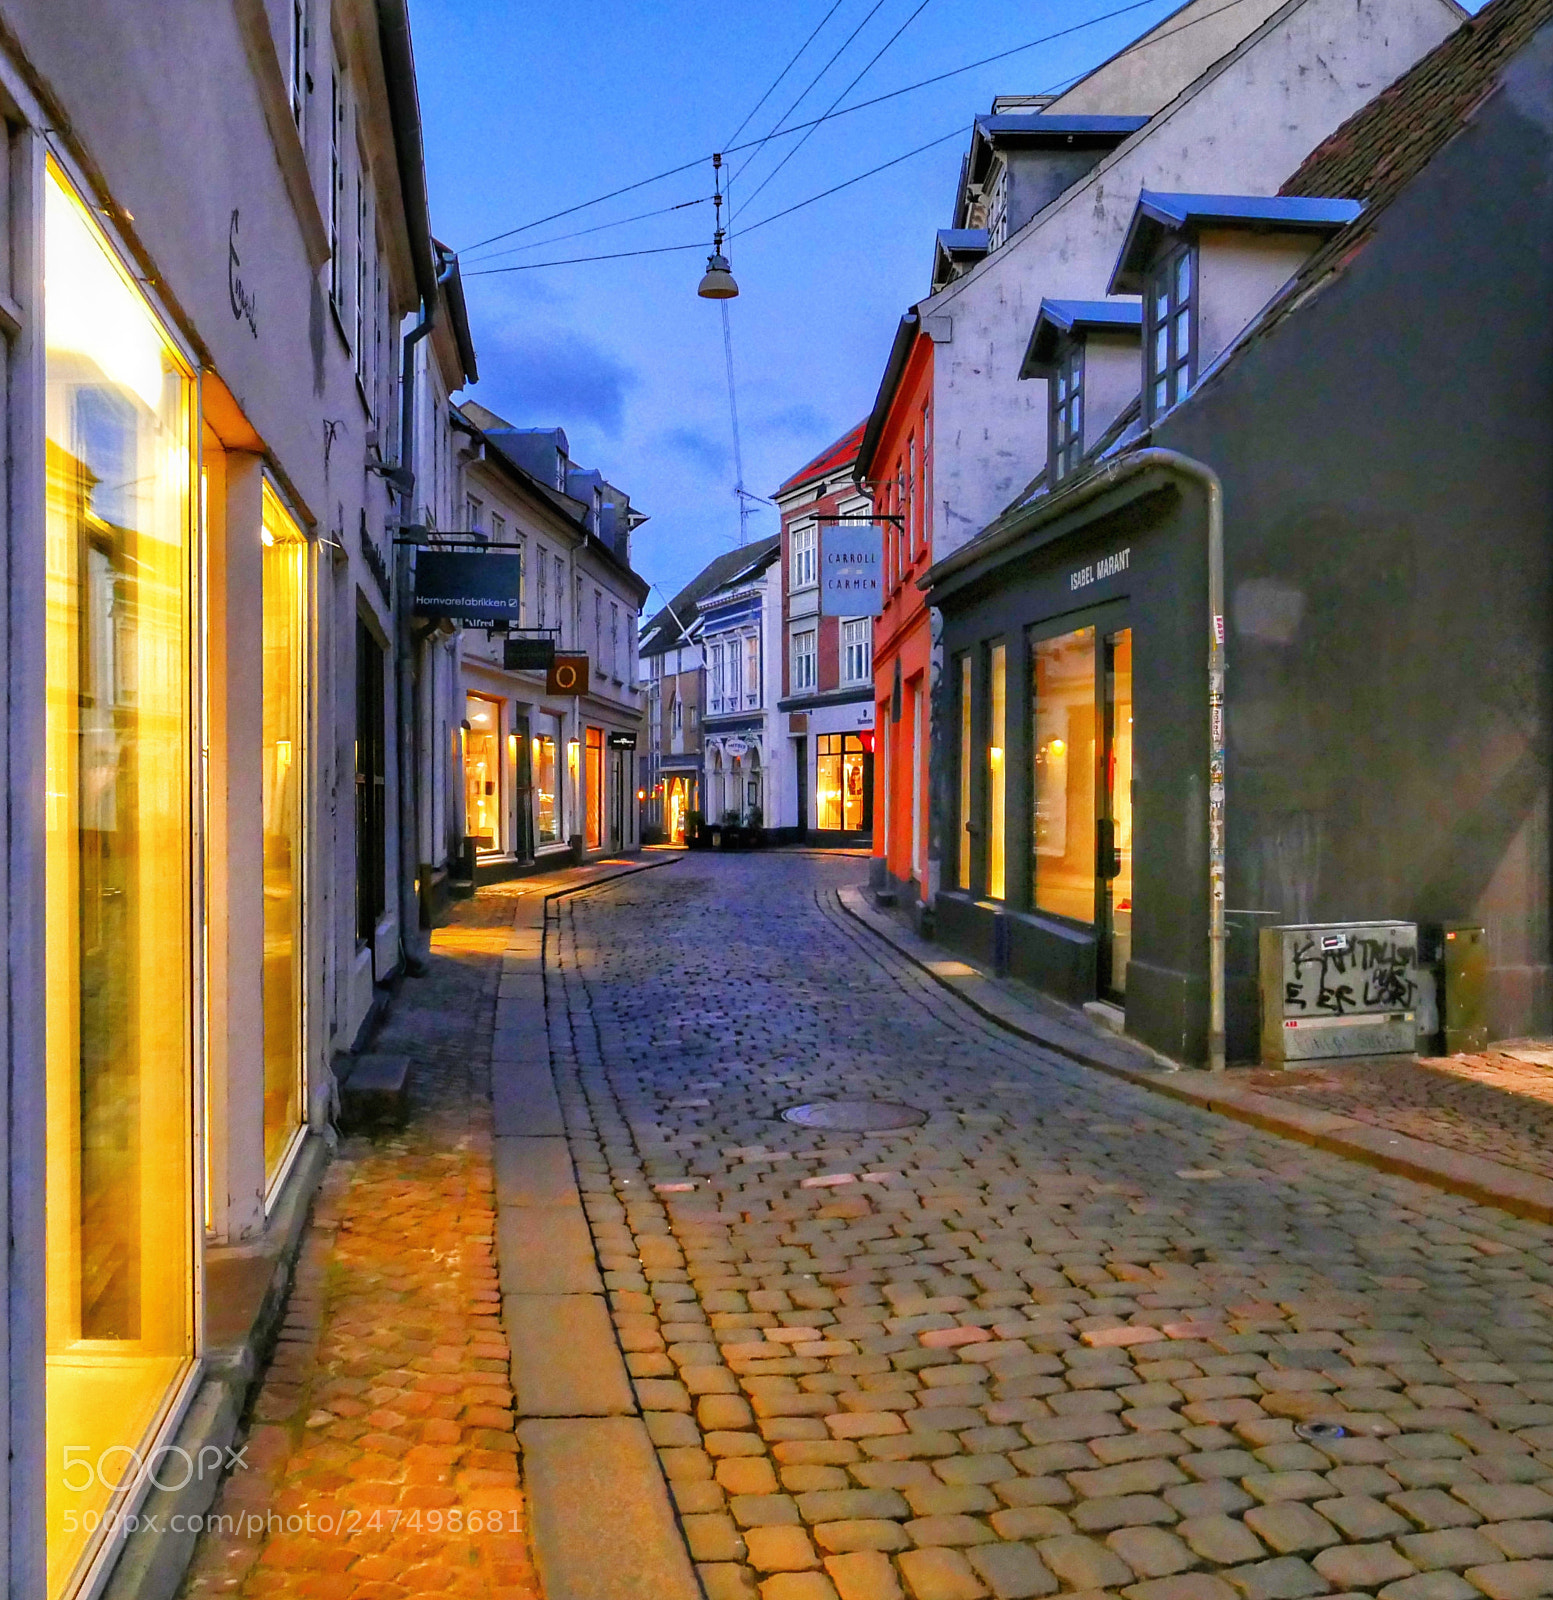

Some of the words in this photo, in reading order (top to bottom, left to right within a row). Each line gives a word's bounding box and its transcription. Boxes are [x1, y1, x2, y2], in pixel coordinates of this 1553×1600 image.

[828, 553, 875, 564] CARROLL
[1071, 565, 1094, 590] ISABEL
[1097, 547, 1130, 580] MARANT
[828, 579, 876, 589] CARMEN
[416, 596, 506, 607] Hornvarefabrikken
